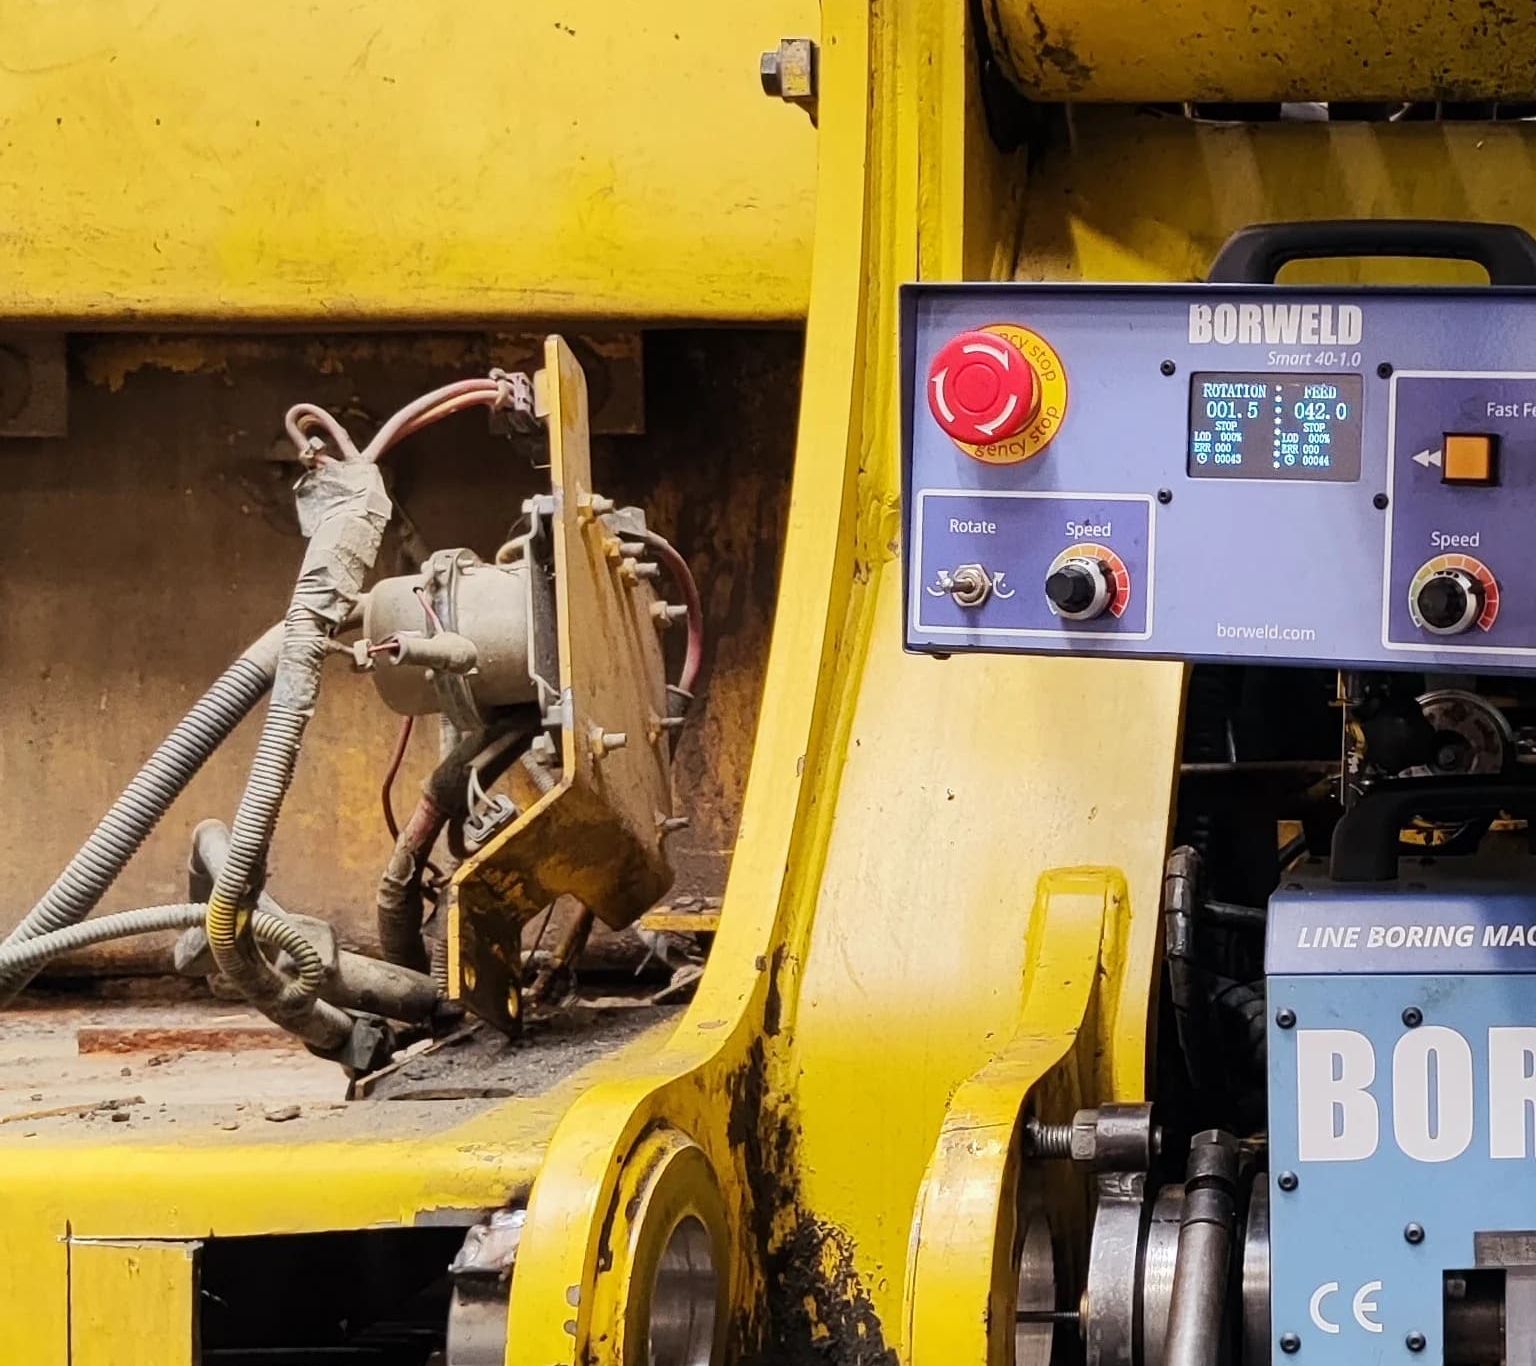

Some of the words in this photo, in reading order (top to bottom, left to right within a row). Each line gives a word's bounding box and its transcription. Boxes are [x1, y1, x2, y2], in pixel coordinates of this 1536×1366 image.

[1188, 303, 1363, 346] BORWELD
[1030, 346, 1056, 381] stop
[1267, 350, 1313, 366] Smart
[1315, 351, 1361, 367] 40-1.0
[1203, 383, 1267, 398] ROTATION
[1304, 386, 1337, 399] FEED
[1487, 403, 1518, 417] Fast
[1029, 406, 1059, 443] stop
[1215, 421, 1237, 431] STOP
[1303, 423, 1325, 433] STOP
[1220, 432, 1242, 442] 000%
[1308, 433, 1330, 444] 000%
[1194, 443, 1211, 453] ERR
[1215, 443, 1232, 453] 000
[1281, 444, 1299, 454] ERR
[1303, 444, 1320, 454] 000
[1214, 454, 1242, 464] 00043
[1302, 455, 1330, 466] 00044
[949, 519, 997, 535] Rotate
[1065, 521, 1112, 540] Speed
[1431, 532, 1480, 550] Speed
[1216, 623, 1315, 641] borweld.com
[1297, 925, 1360, 949] LINE
[1366, 924, 1474, 949] BORING
[1309, 1279, 1384, 1334] CE
